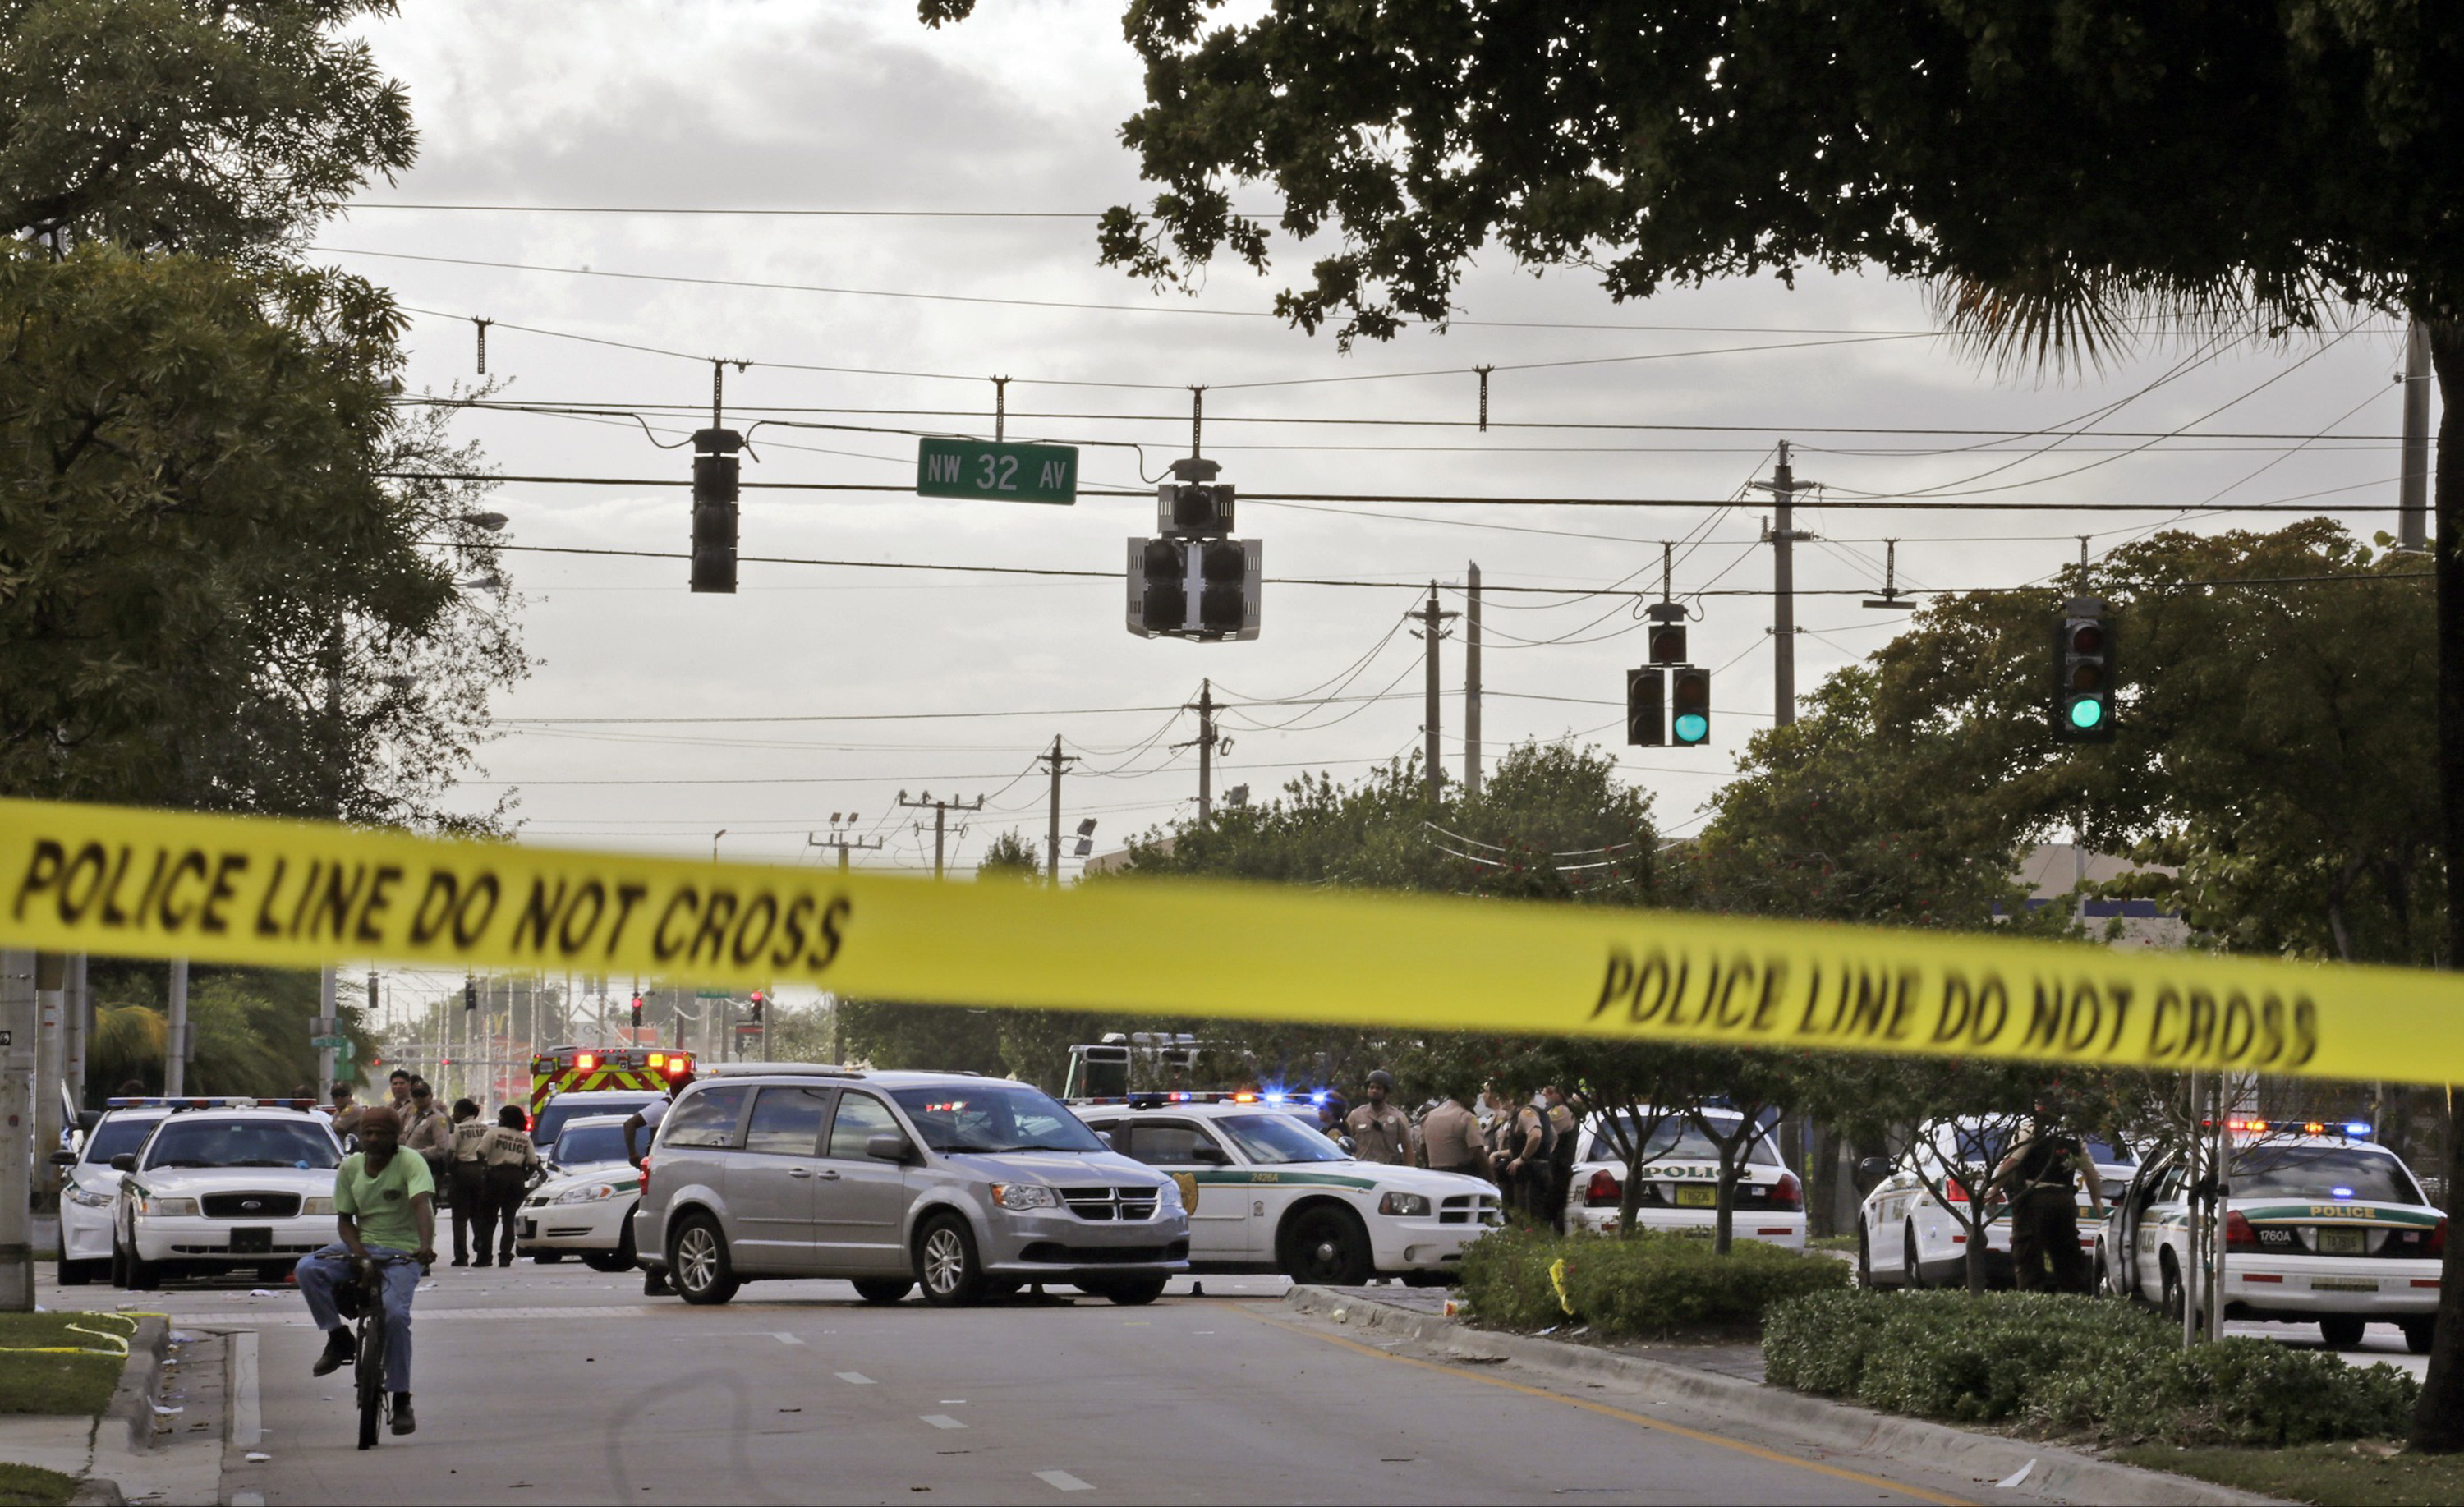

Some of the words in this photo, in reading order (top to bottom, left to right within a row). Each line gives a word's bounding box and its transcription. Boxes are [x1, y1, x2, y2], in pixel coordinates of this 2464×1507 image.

[928, 454, 961, 483] NW
[976, 453, 1018, 490] 32
[1038, 460, 1066, 489] AV
[12, 839, 250, 935] POLICE
[255, 855, 404, 945] LINE
[410, 869, 501, 950] DO
[509, 874, 649, 963] NOT
[652, 884, 852, 972] CROSS
[1588, 941, 1791, 1031] POLICE
[1795, 956, 1922, 1041] LINE
[1930, 967, 2009, 1046] DO
[2020, 972, 2135, 1054] NOT
[2149, 984, 2319, 1067] CROSS
[460, 1128, 487, 1140] POLIC
[495, 1139, 529, 1155] POLICE
[1251, 1173, 1278, 1182] 2426A
[1641, 1166, 1752, 1181] POLI
[2310, 1206, 2376, 1219] POLICE
[2259, 1230, 2292, 1242] 1760A
